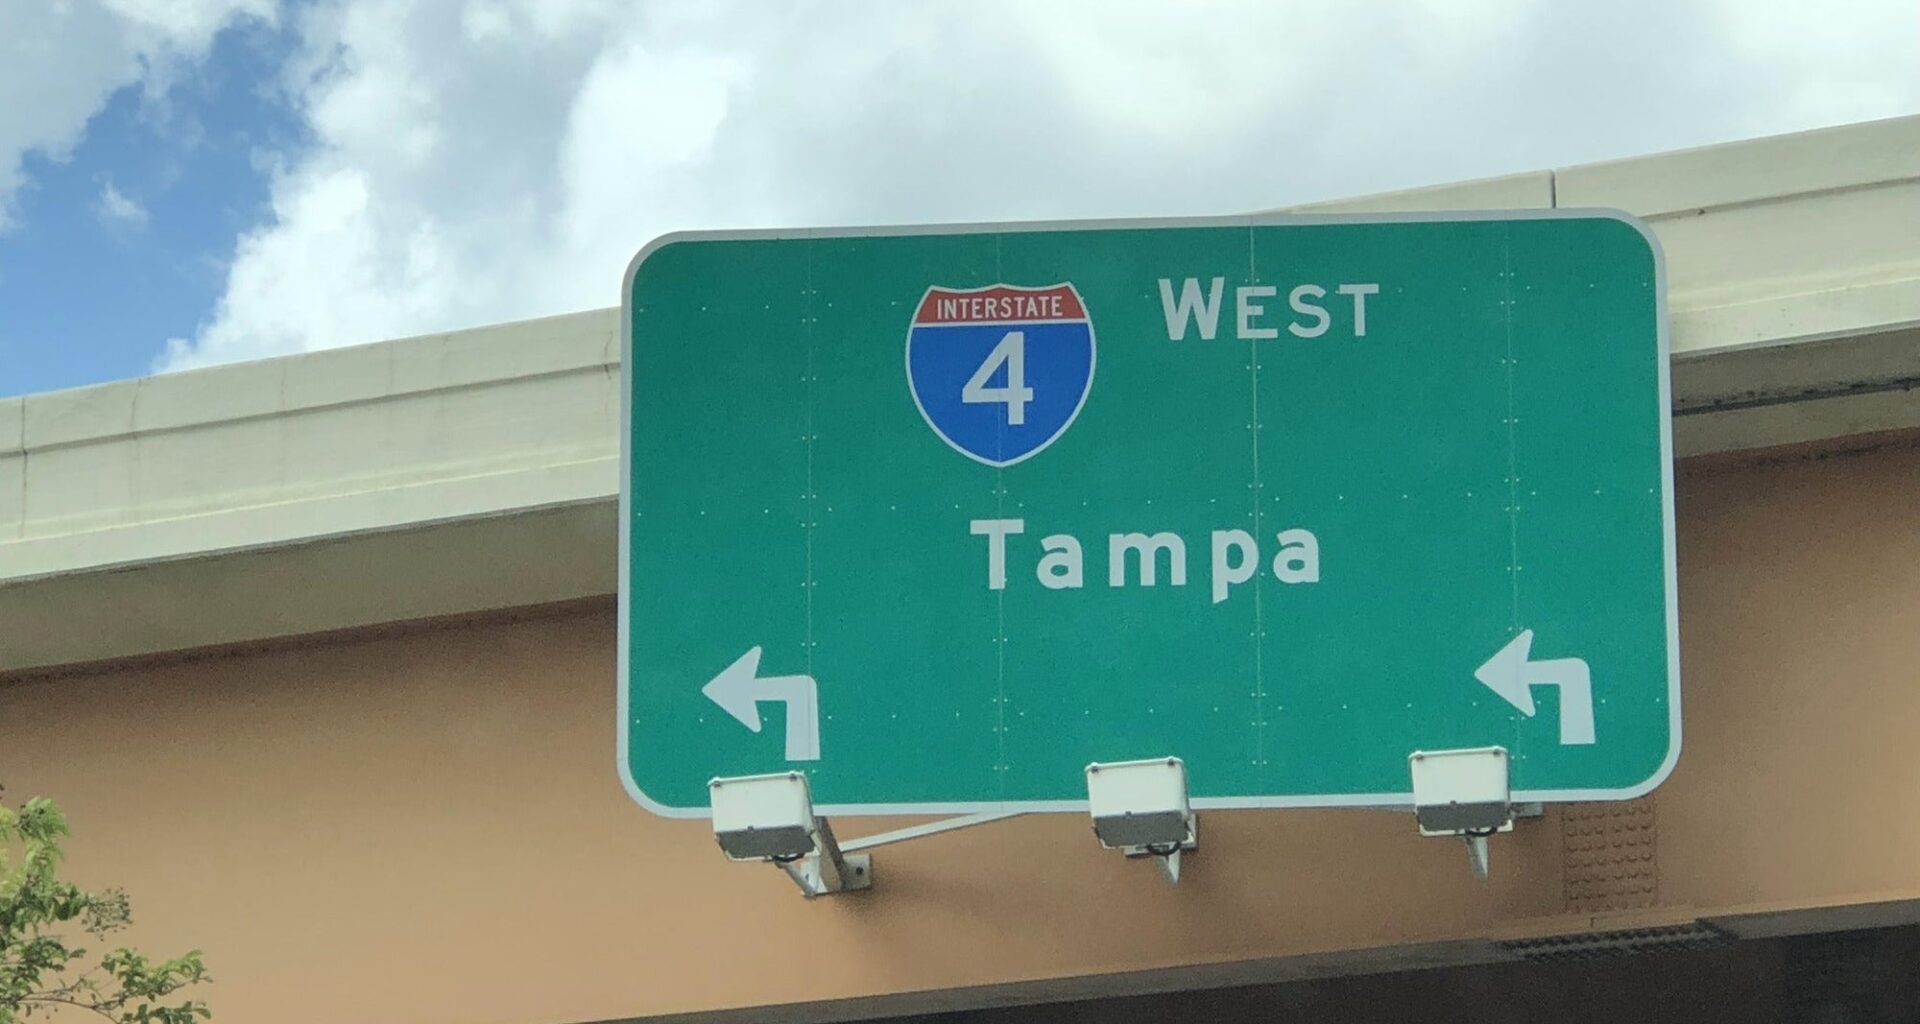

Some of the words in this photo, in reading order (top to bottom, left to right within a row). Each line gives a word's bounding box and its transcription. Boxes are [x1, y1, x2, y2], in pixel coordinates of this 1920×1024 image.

[936, 295, 1064, 320] INTERSTATE
[1158, 277, 1380, 340] WEST
[962, 331, 1034, 426] 4
[970, 519, 1320, 604] Tampa
